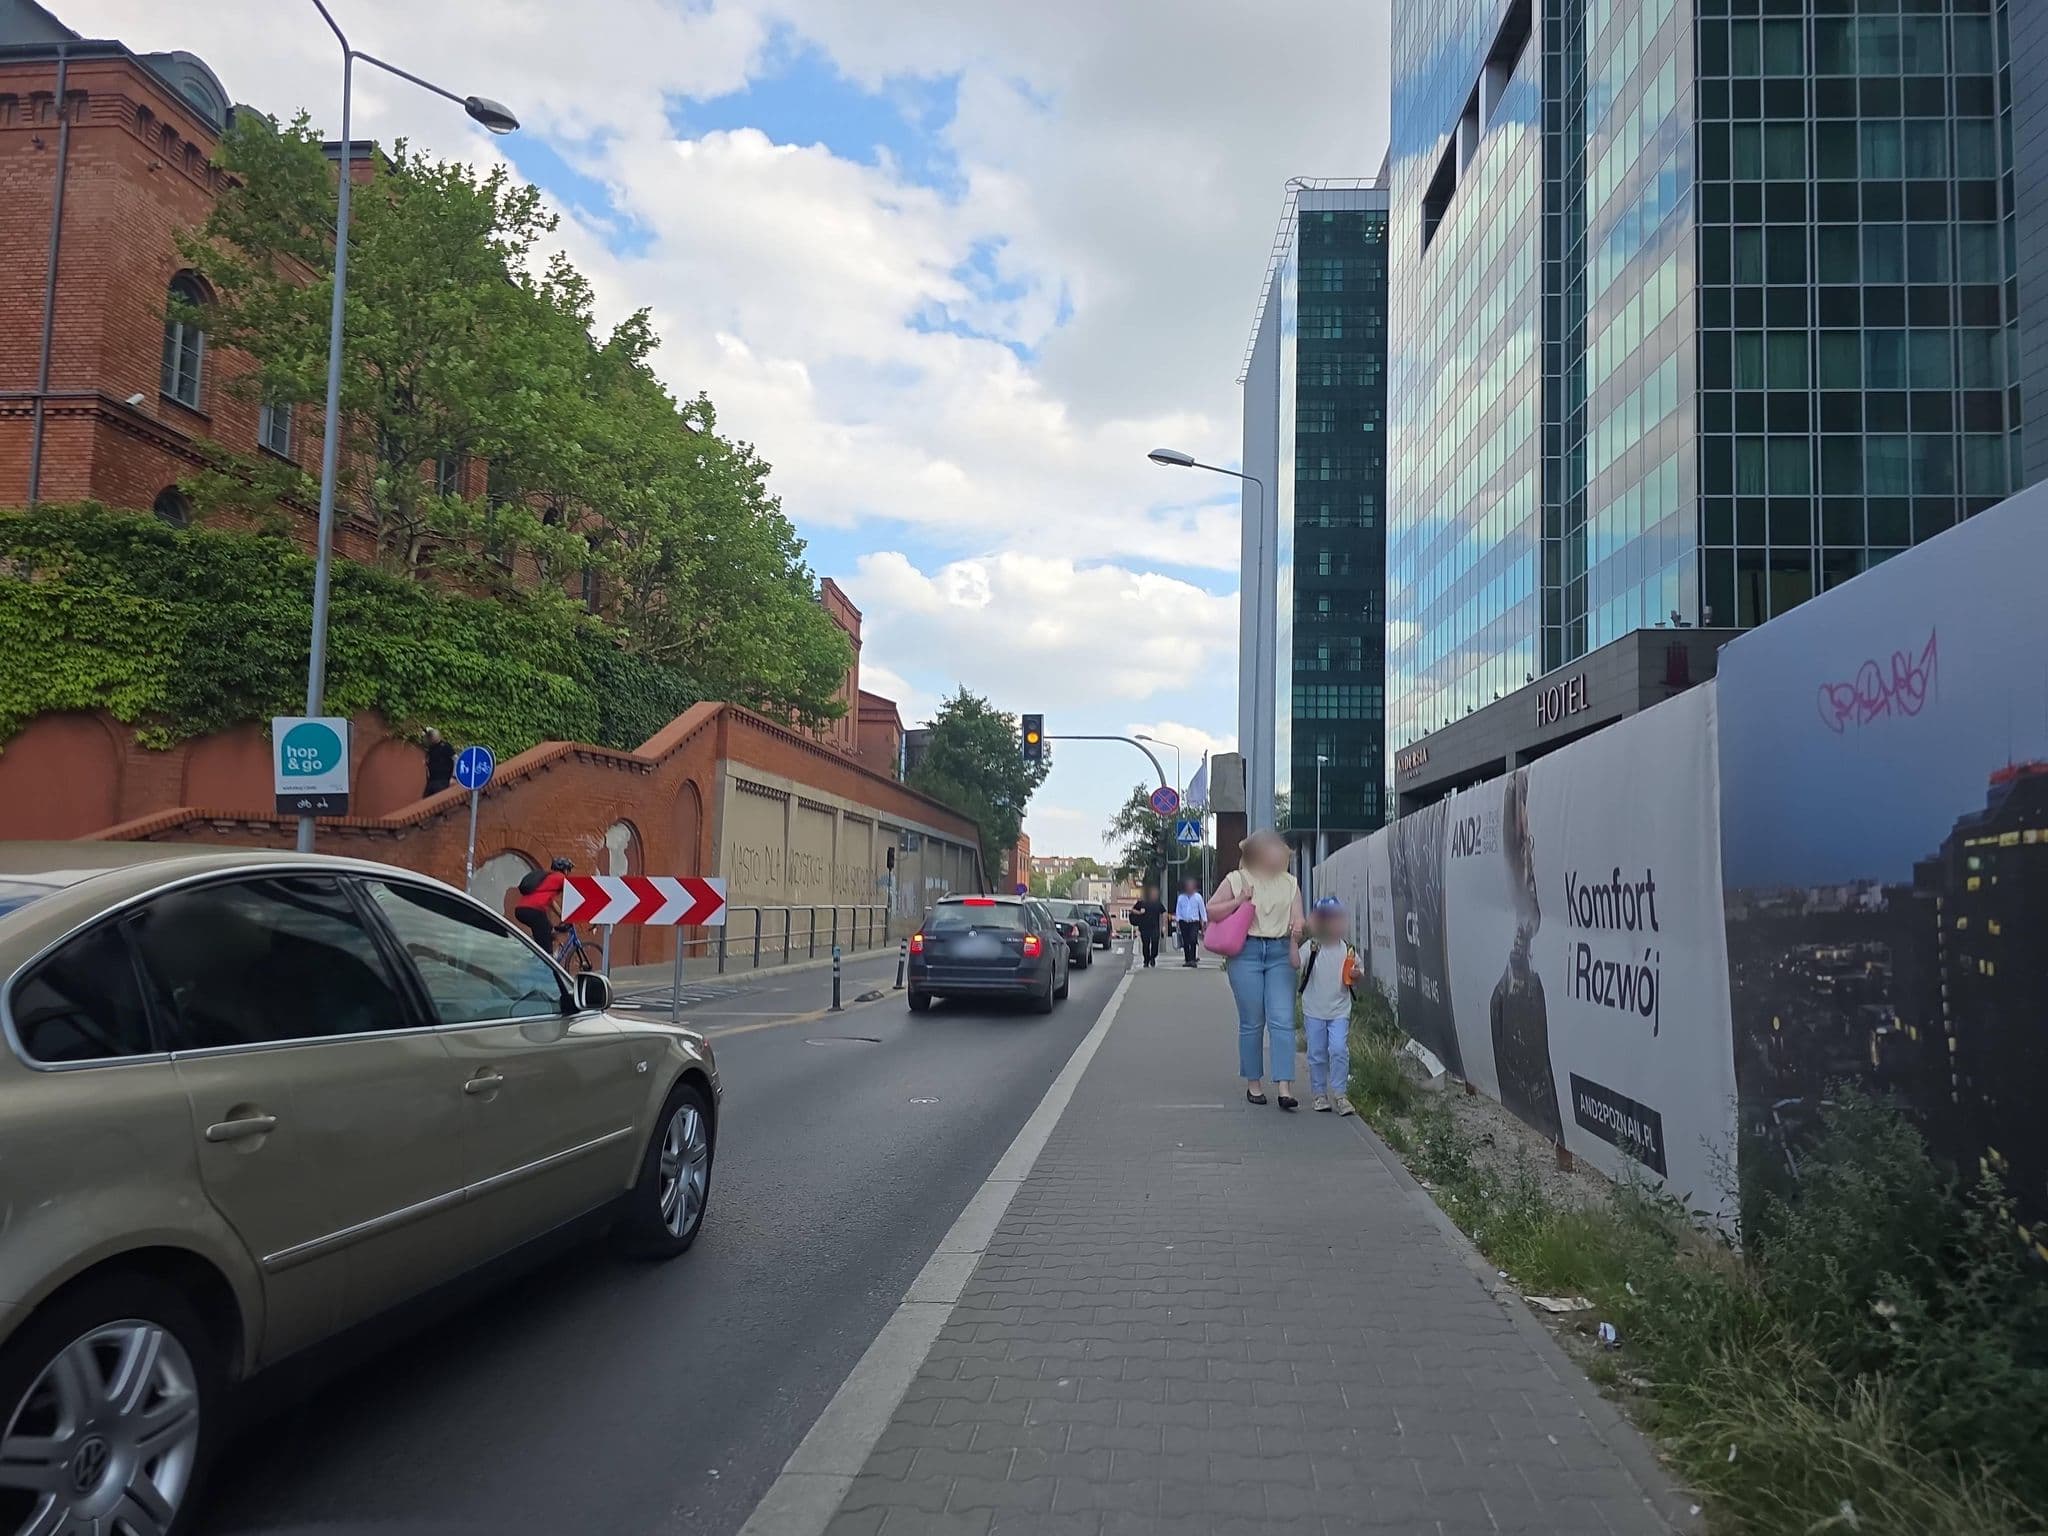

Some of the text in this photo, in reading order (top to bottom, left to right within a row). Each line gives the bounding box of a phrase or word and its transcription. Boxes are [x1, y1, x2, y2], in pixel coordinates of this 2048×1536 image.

[1536, 674, 1590, 727] HOTEL
[286, 745, 318, 759] hop
[287, 758, 323, 773] & go
[1451, 816, 1482, 859] AND2
[1564, 867, 1659, 932] Komfort
[1566, 942, 1661, 1037] i Rozwój
[1579, 1091, 1657, 1154] AND2POZNAN.PL
